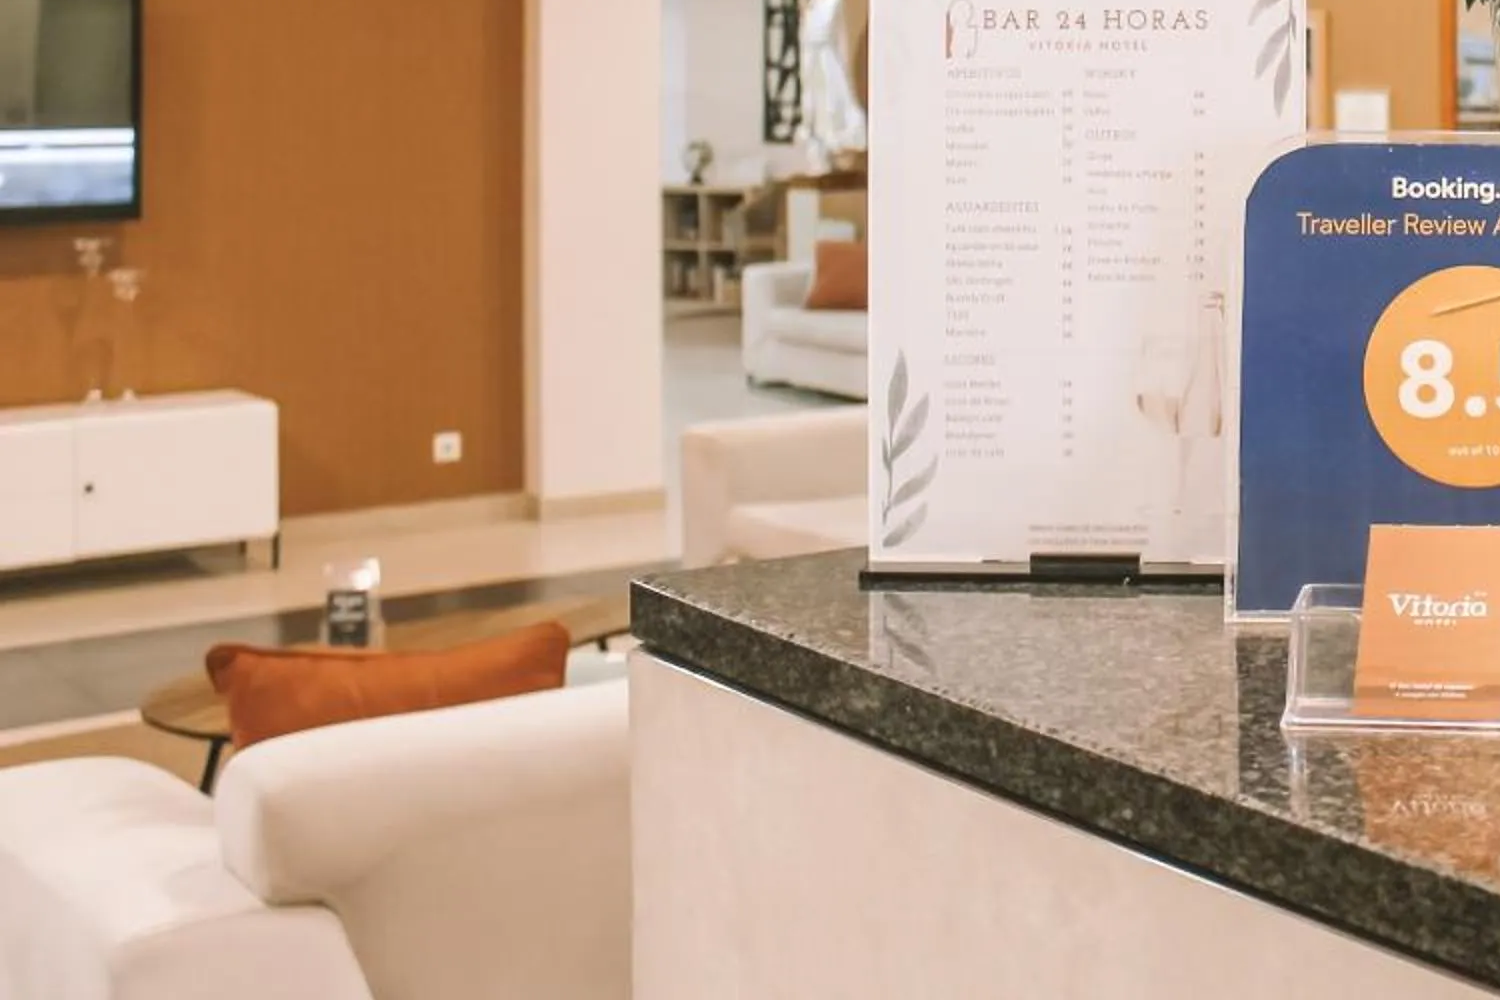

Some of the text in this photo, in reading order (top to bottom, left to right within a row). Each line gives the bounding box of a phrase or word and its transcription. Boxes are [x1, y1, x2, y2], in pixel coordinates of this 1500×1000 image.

[983, 9, 1209, 31] BAR 24 HORAS
[1099, 40, 1149, 52] HOTEL
[1296, 211, 1396, 236] Traveller
[1404, 212, 1486, 236] Review
[1448, 443, 1469, 457] out
[1470, 443, 1484, 457] of
